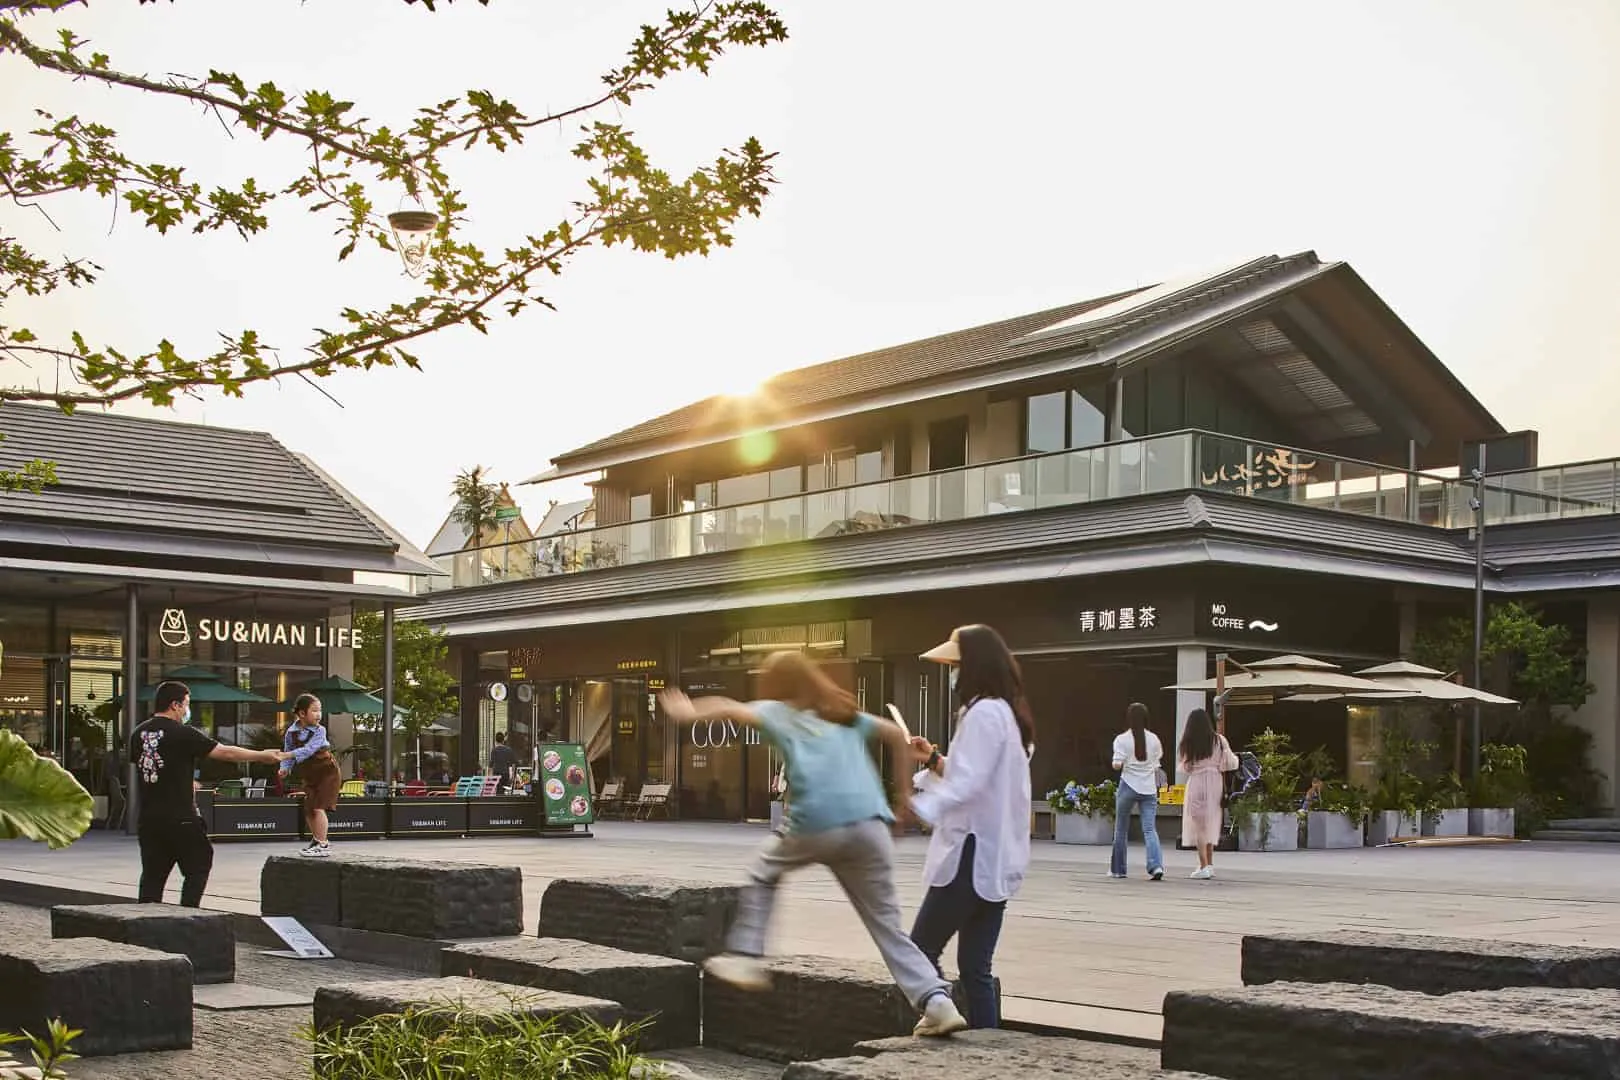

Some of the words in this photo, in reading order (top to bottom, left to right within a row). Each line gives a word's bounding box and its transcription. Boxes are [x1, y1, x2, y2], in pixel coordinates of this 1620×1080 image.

[1079, 605, 1156, 632] 青咖墨茶
[1212, 603, 1226, 615] MO
[1212, 616, 1245, 630] COFFEE
[199, 618, 305, 646] SU&MAN
[315, 626, 363, 649] LIFE
